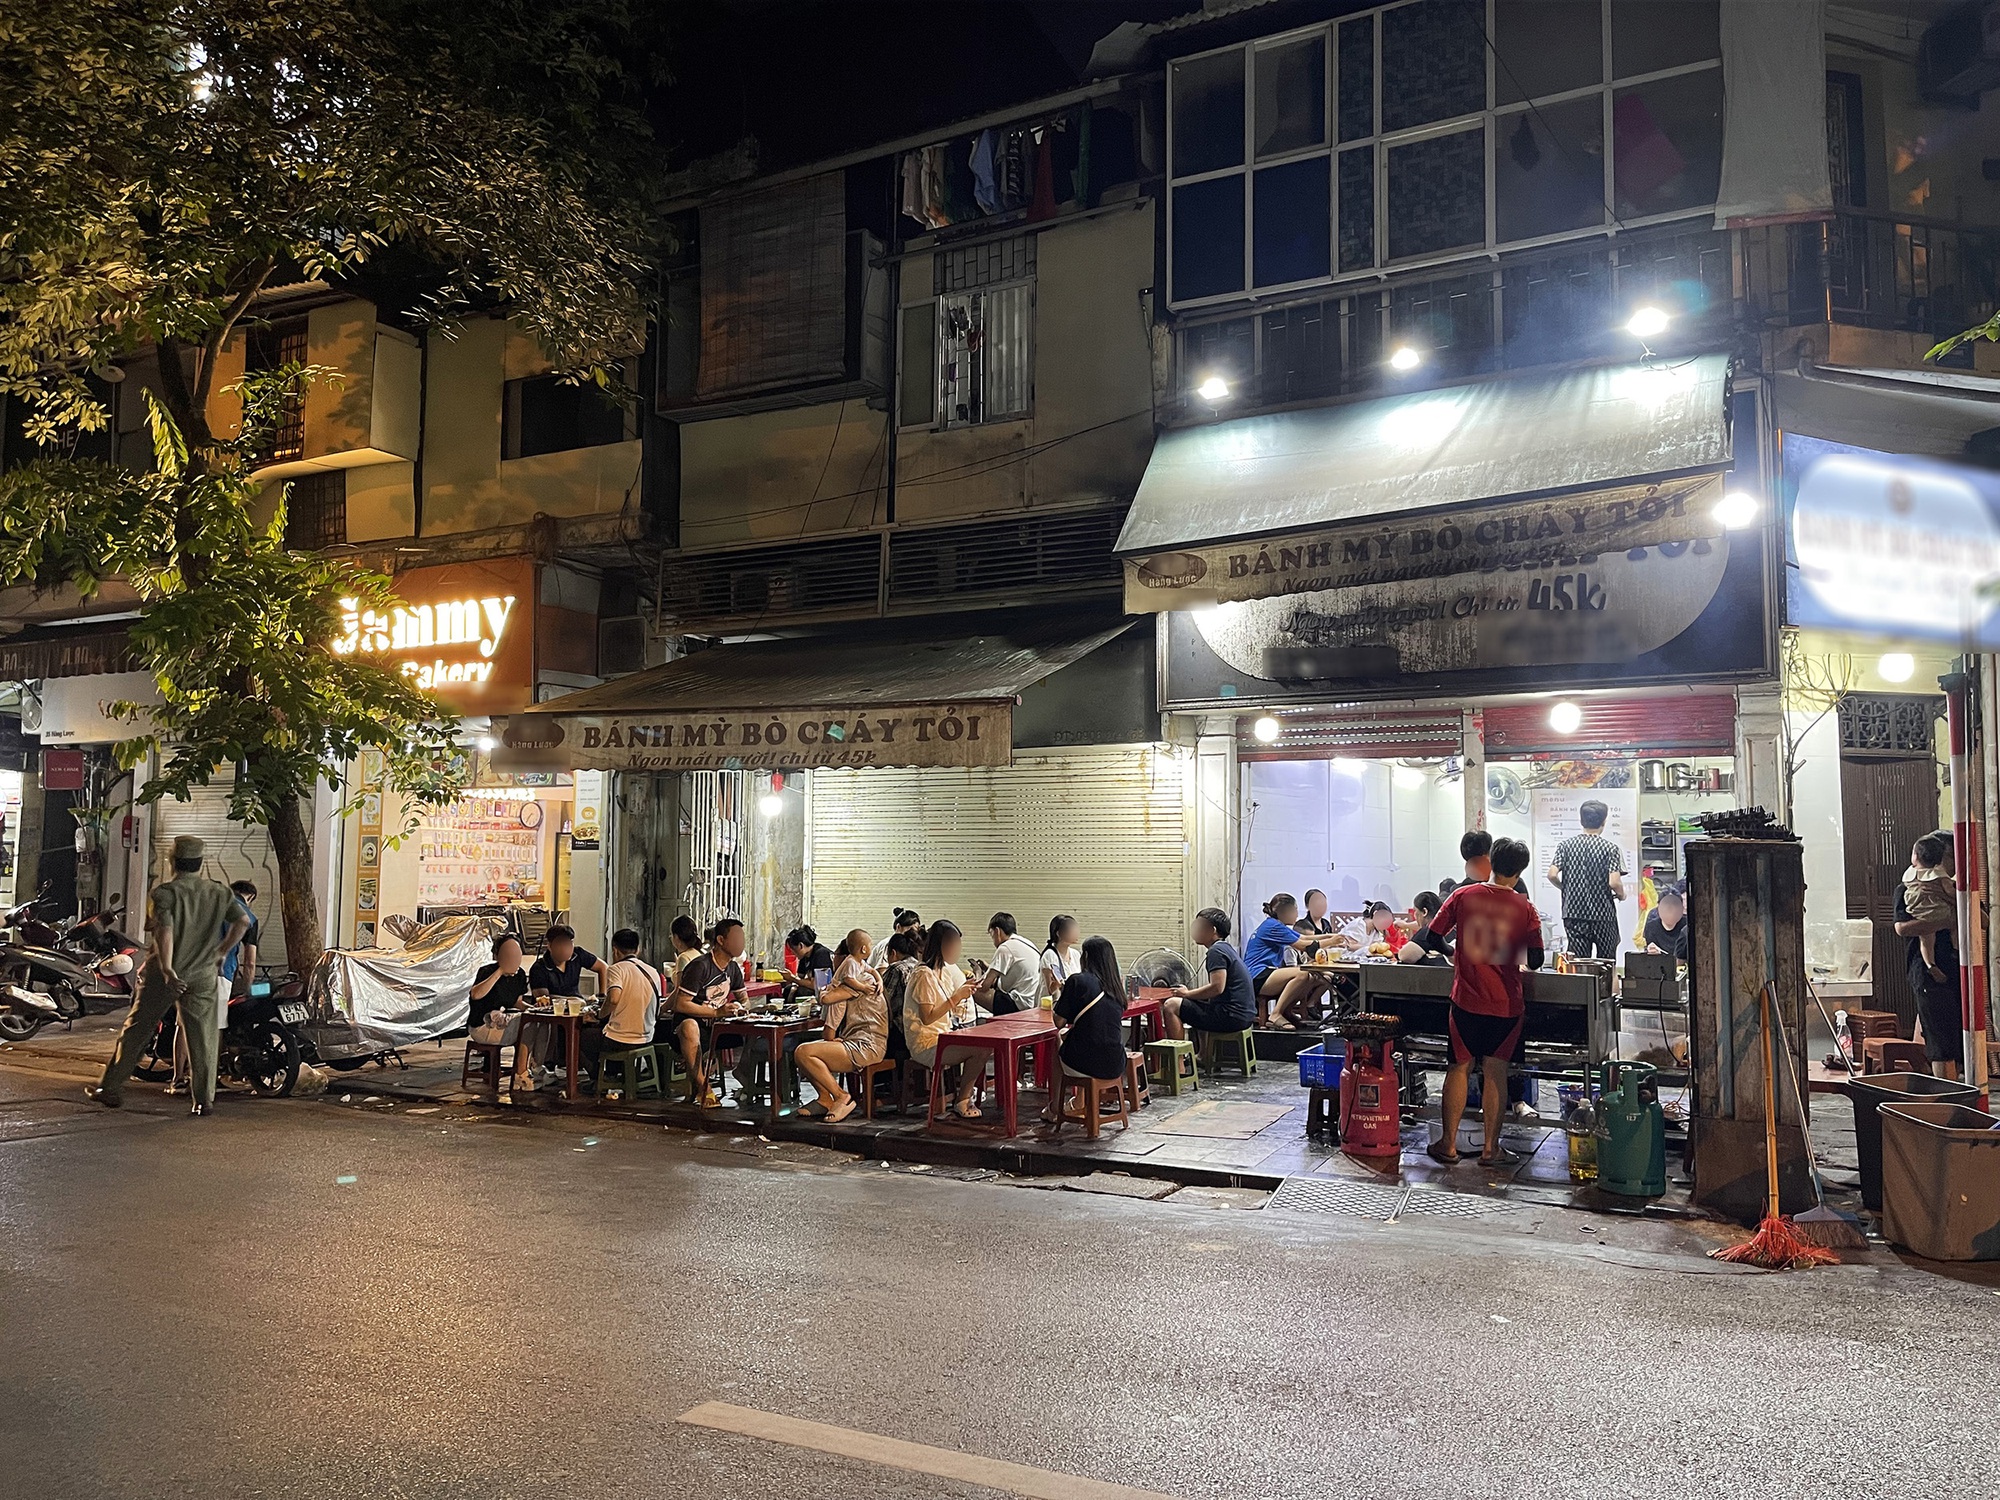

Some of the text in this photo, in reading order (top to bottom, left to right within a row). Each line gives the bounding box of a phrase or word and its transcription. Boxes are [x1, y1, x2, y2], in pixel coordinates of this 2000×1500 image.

[1229, 485, 1687, 578] BÁNH MỲ BÒ CHÁY TỎI
[1528, 573, 1606, 611] 45k
[582, 706, 981, 749] BÁNH MỲ BÒ CHÁY TỎI
[628, 749, 877, 770] Ngon mất người! chỉ từ 45k
